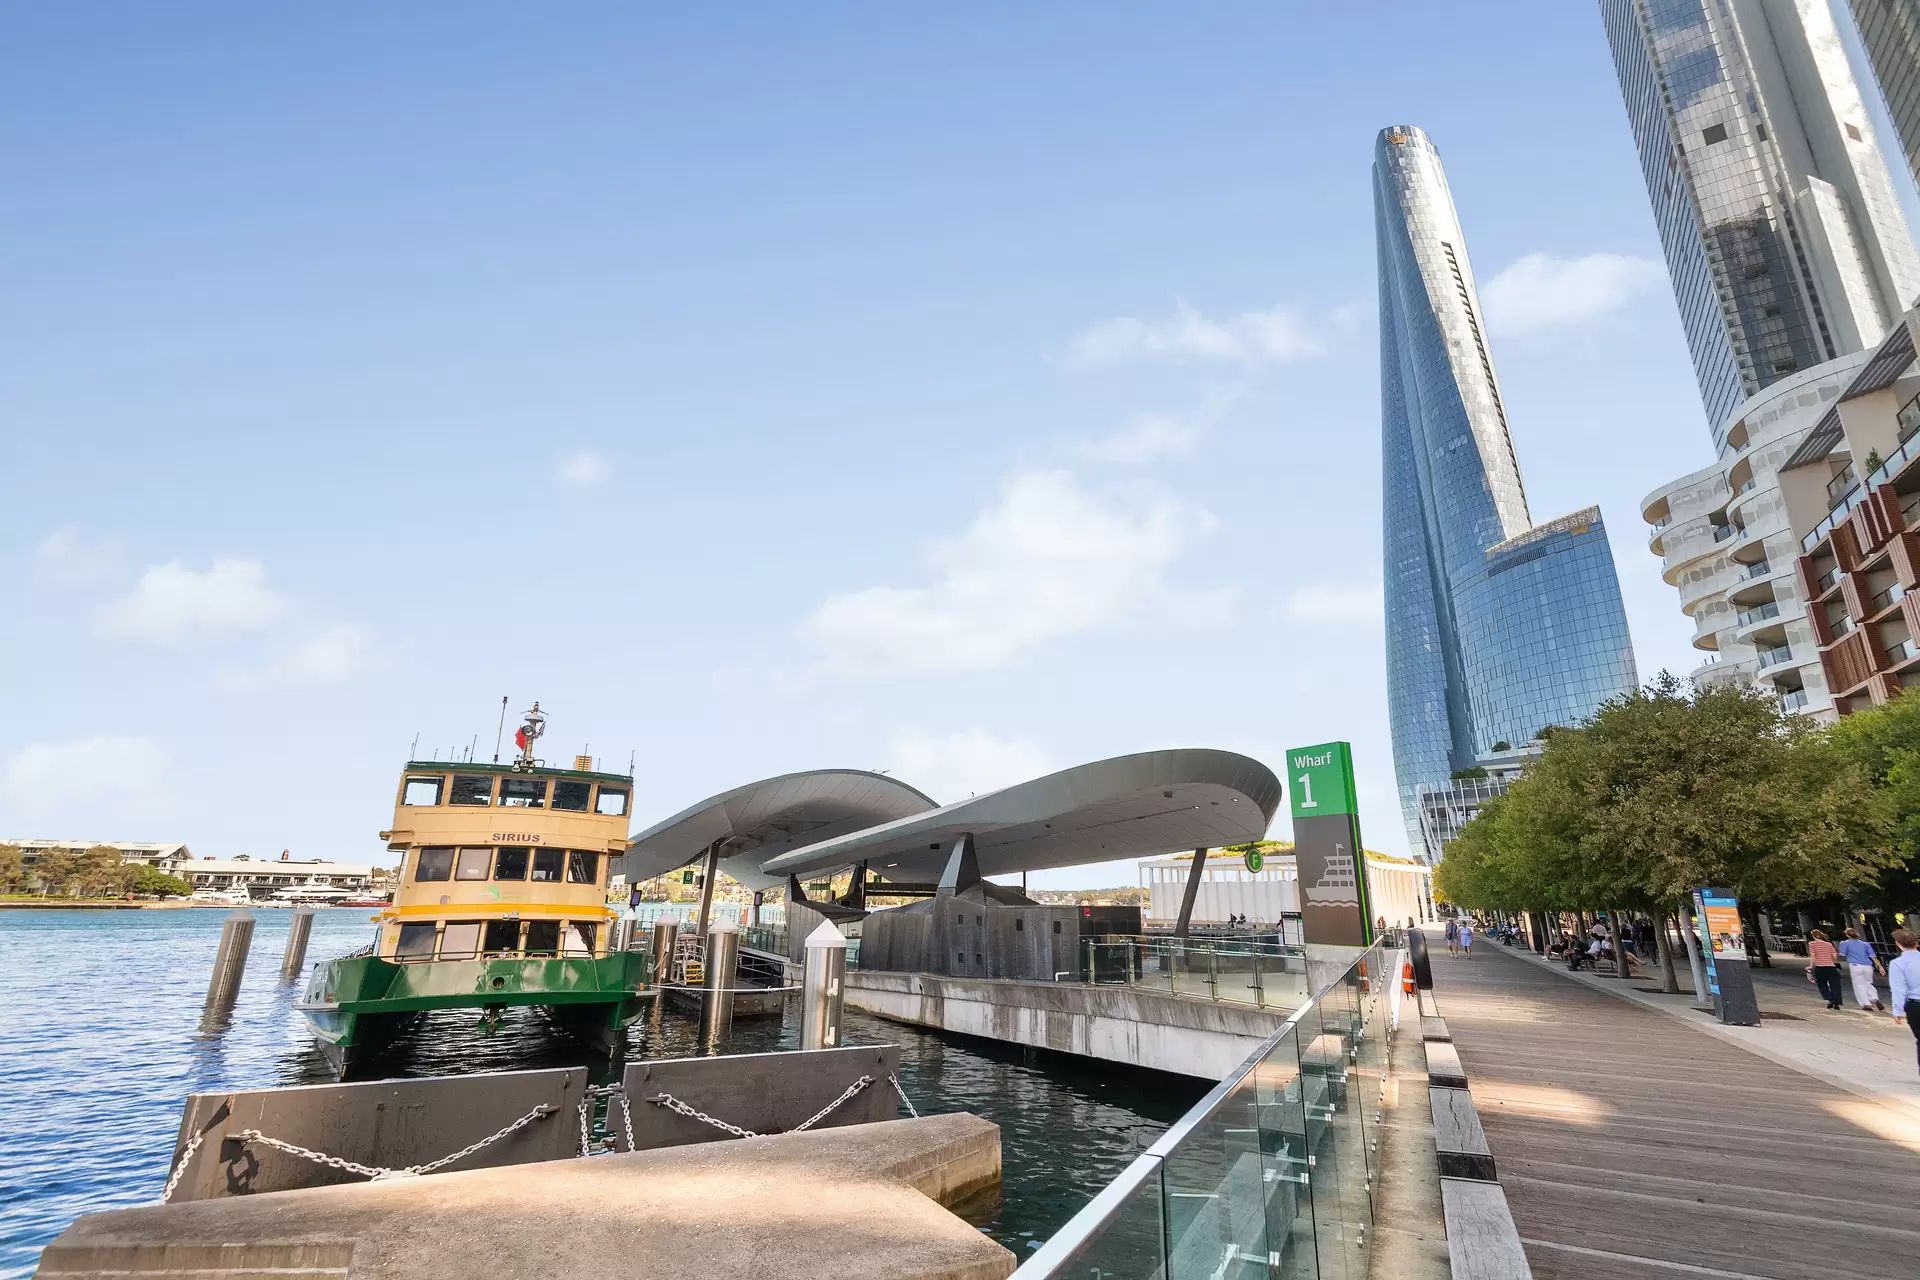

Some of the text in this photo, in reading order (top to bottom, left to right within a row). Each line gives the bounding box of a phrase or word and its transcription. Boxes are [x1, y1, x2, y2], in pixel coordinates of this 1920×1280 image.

[1294, 751, 1332, 769] Wharf
[1298, 773, 1318, 808] 1
[492, 833, 540, 843] SIRIUS
[1252, 854, 1258, 867] F
